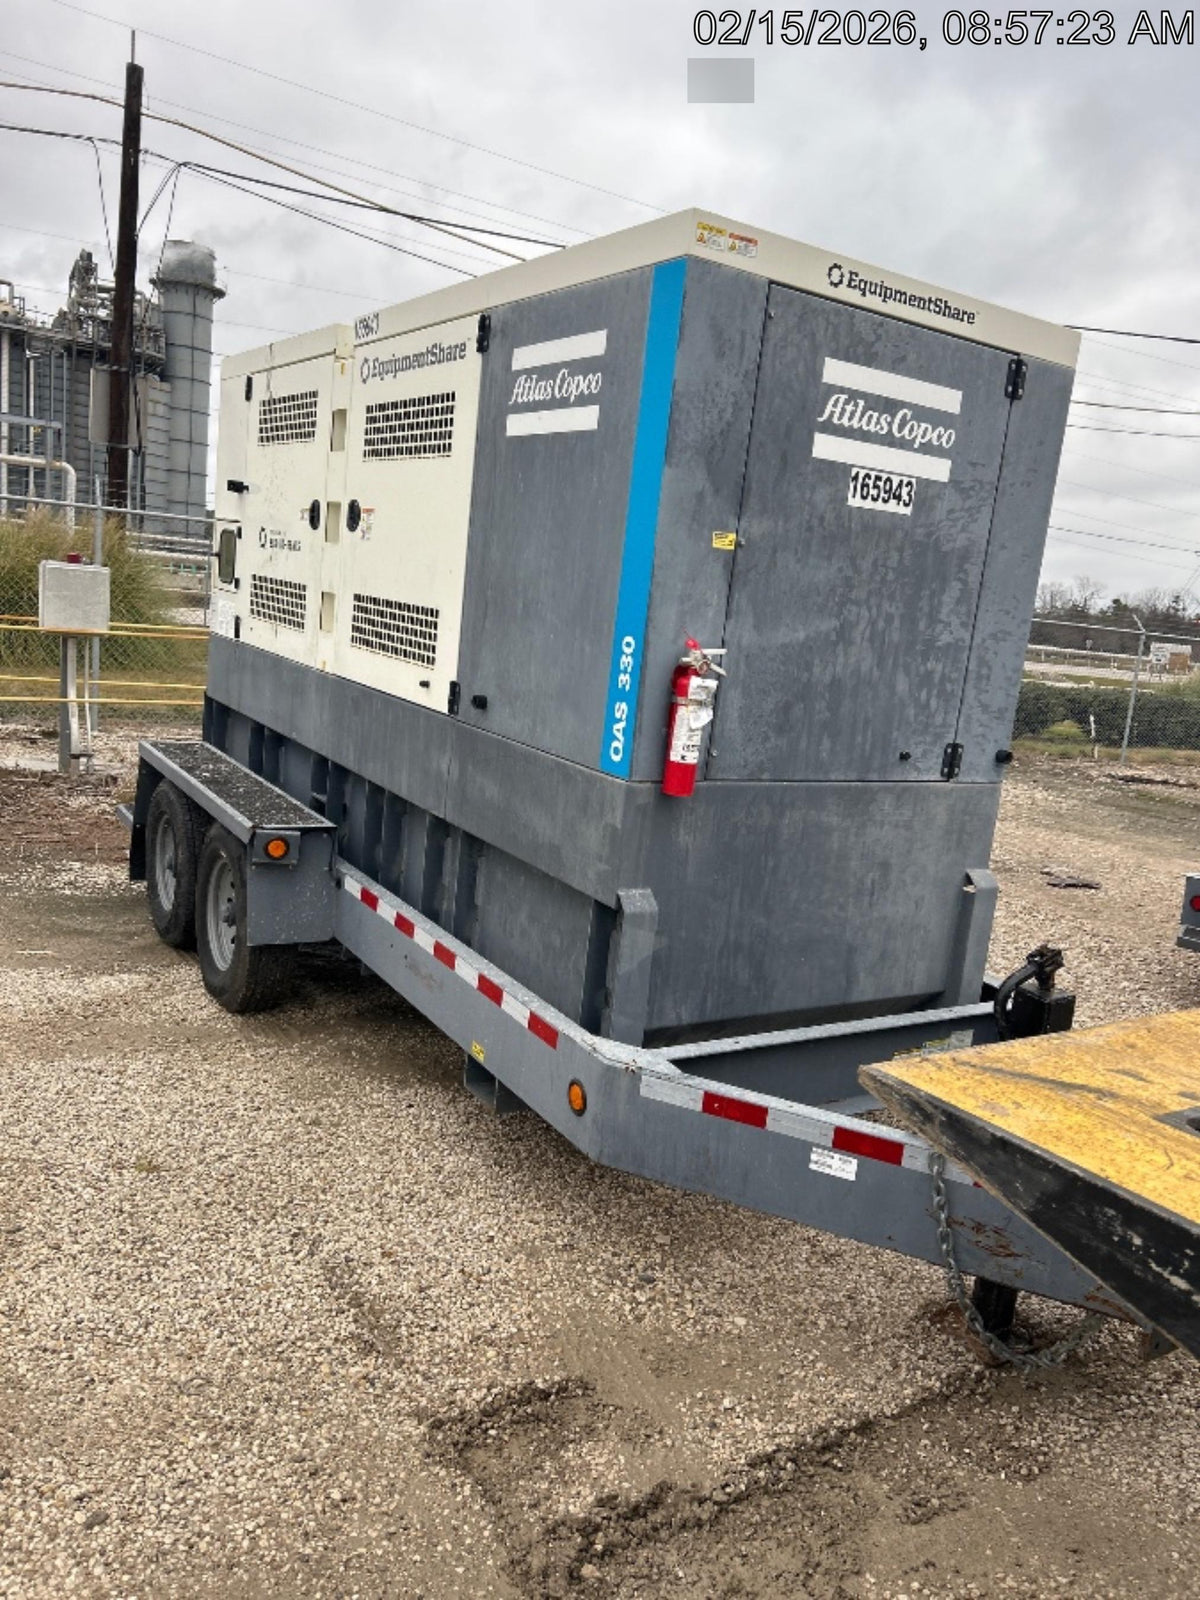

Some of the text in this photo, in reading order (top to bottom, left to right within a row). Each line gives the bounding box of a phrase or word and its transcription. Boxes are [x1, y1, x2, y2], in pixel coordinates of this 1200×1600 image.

[846, 269, 976, 324] EquipmentShare
[371, 341, 467, 381] EquipmentShare
[508, 368, 602, 405] Atlas Copco
[816, 394, 956, 449] Atlas Copco
[851, 471, 914, 507] 165943
[618, 635, 636, 692] 330
